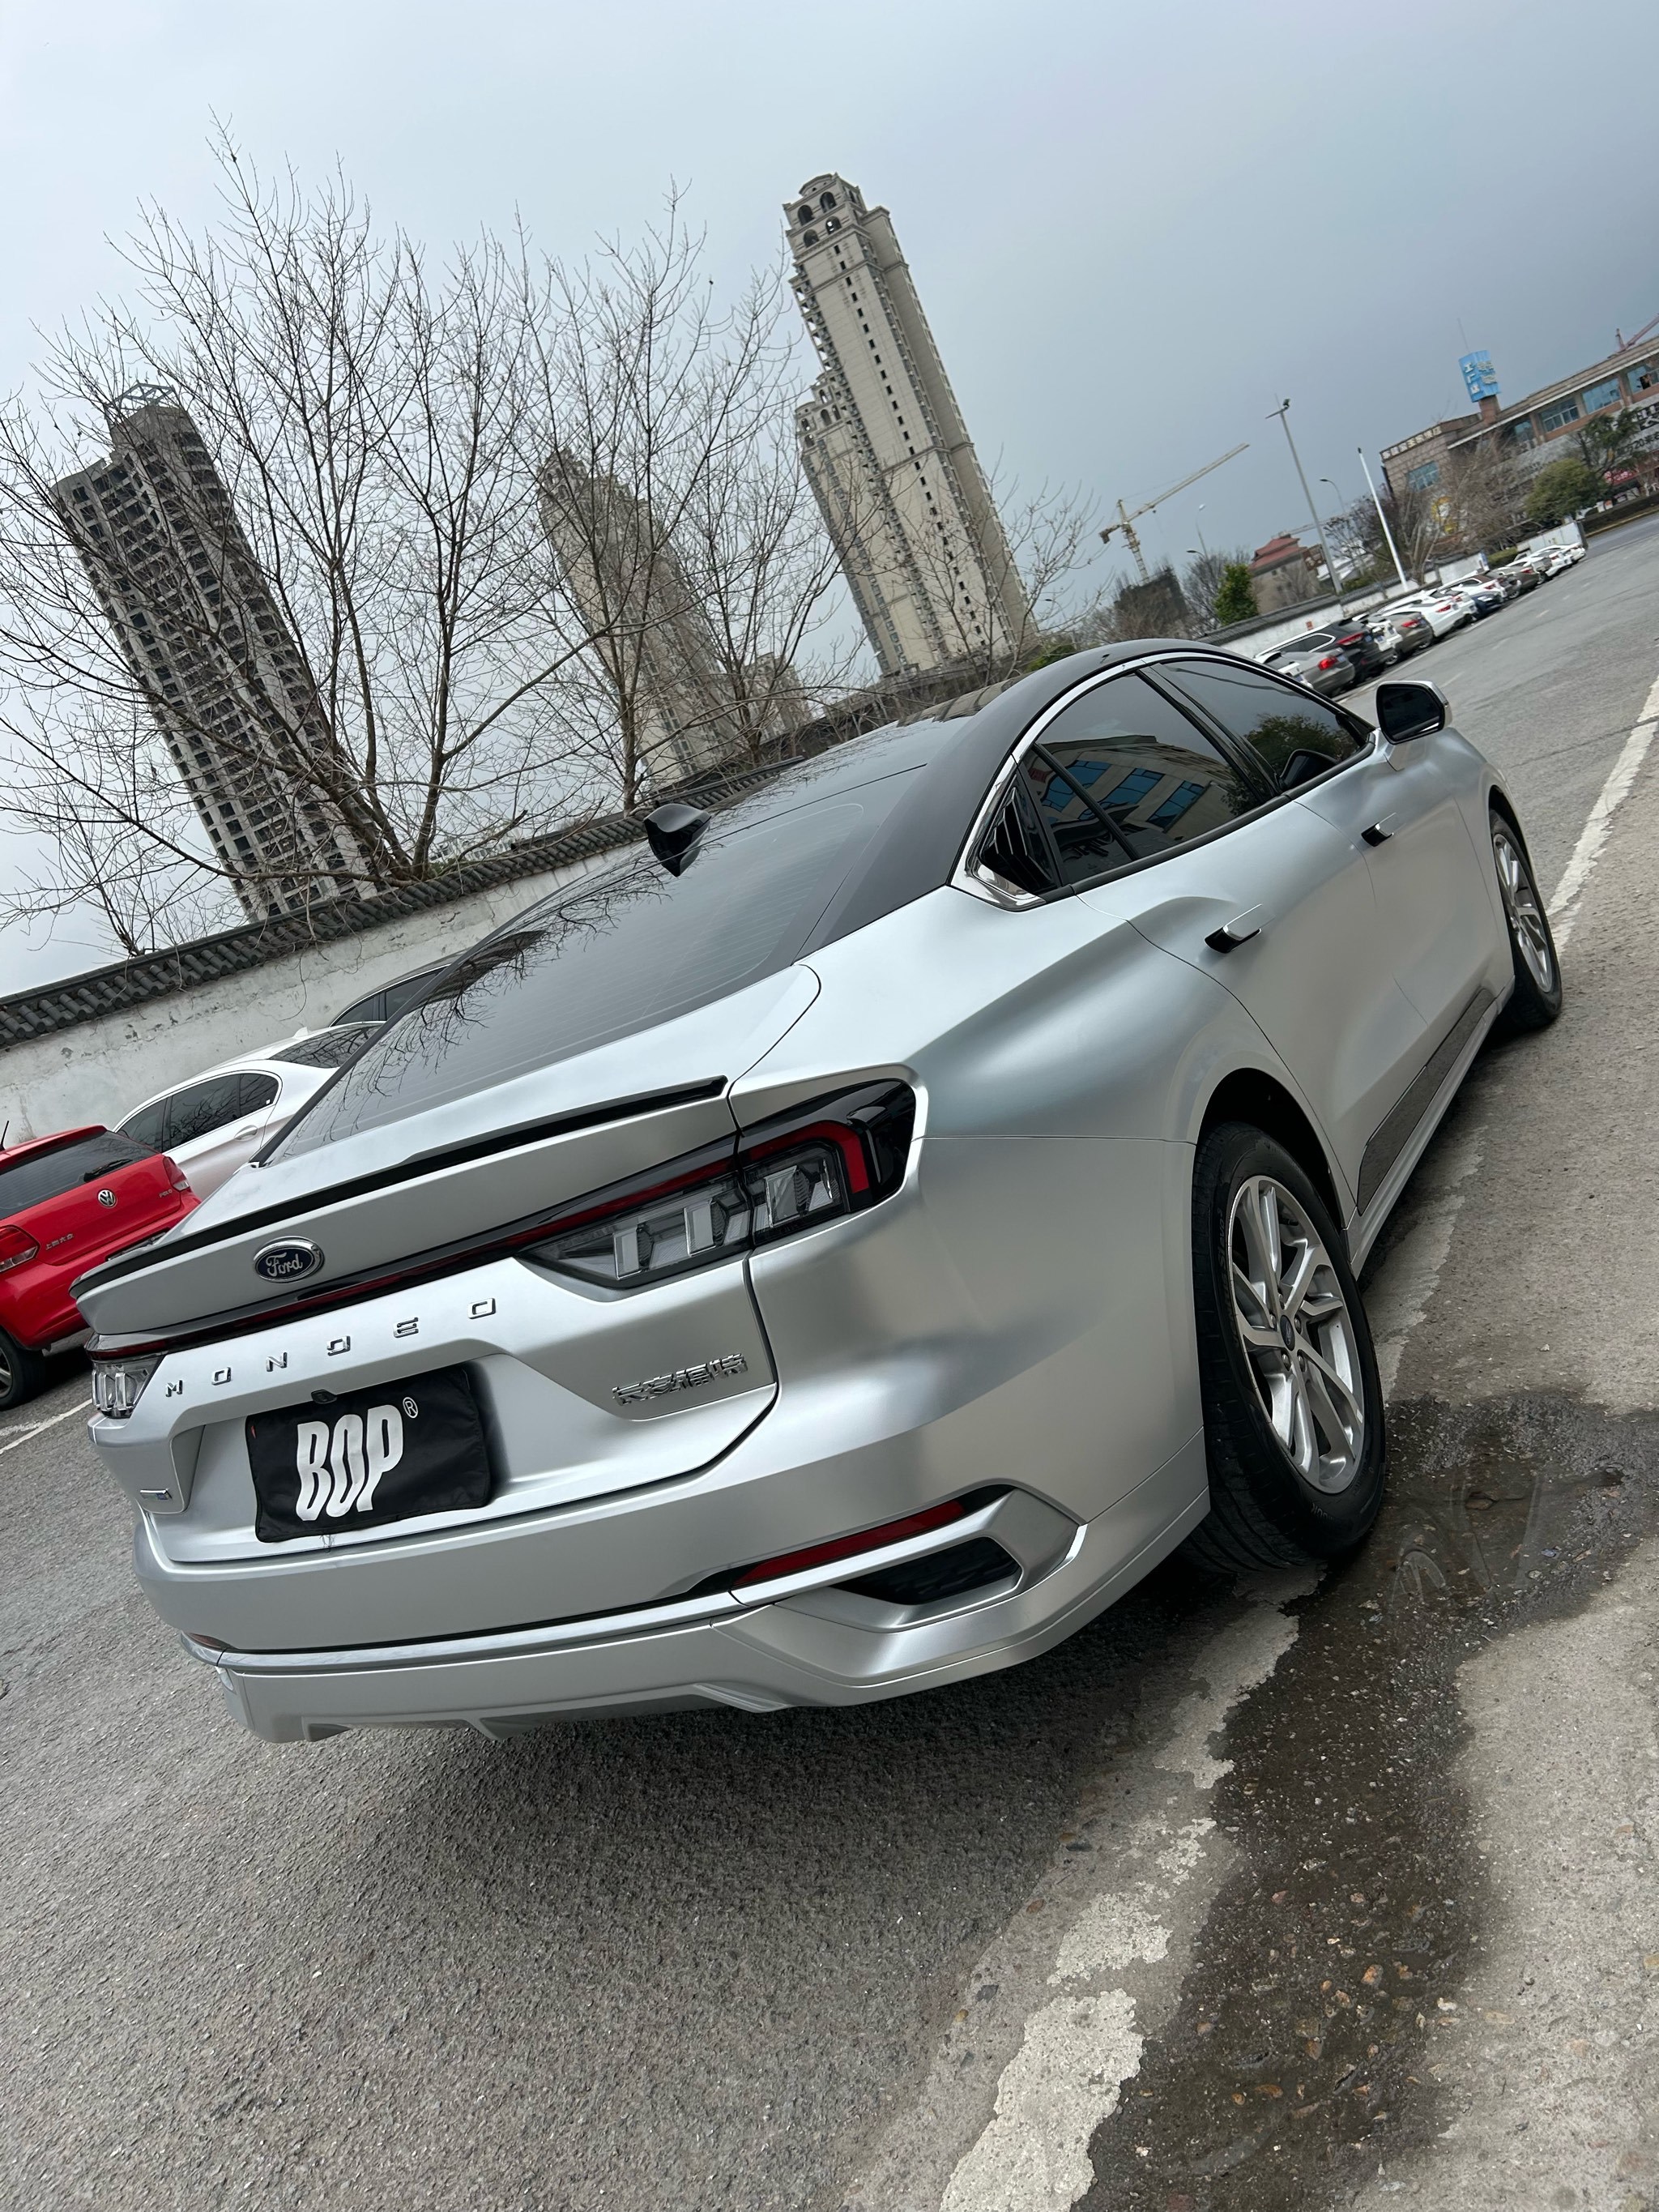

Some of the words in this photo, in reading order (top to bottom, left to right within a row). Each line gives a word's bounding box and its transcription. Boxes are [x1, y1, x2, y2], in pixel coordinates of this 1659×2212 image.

[265, 1252, 304, 1277] Ford
[165, 1297, 497, 1398] MONDEO
[612, 1353, 748, 1406] 长安福特
